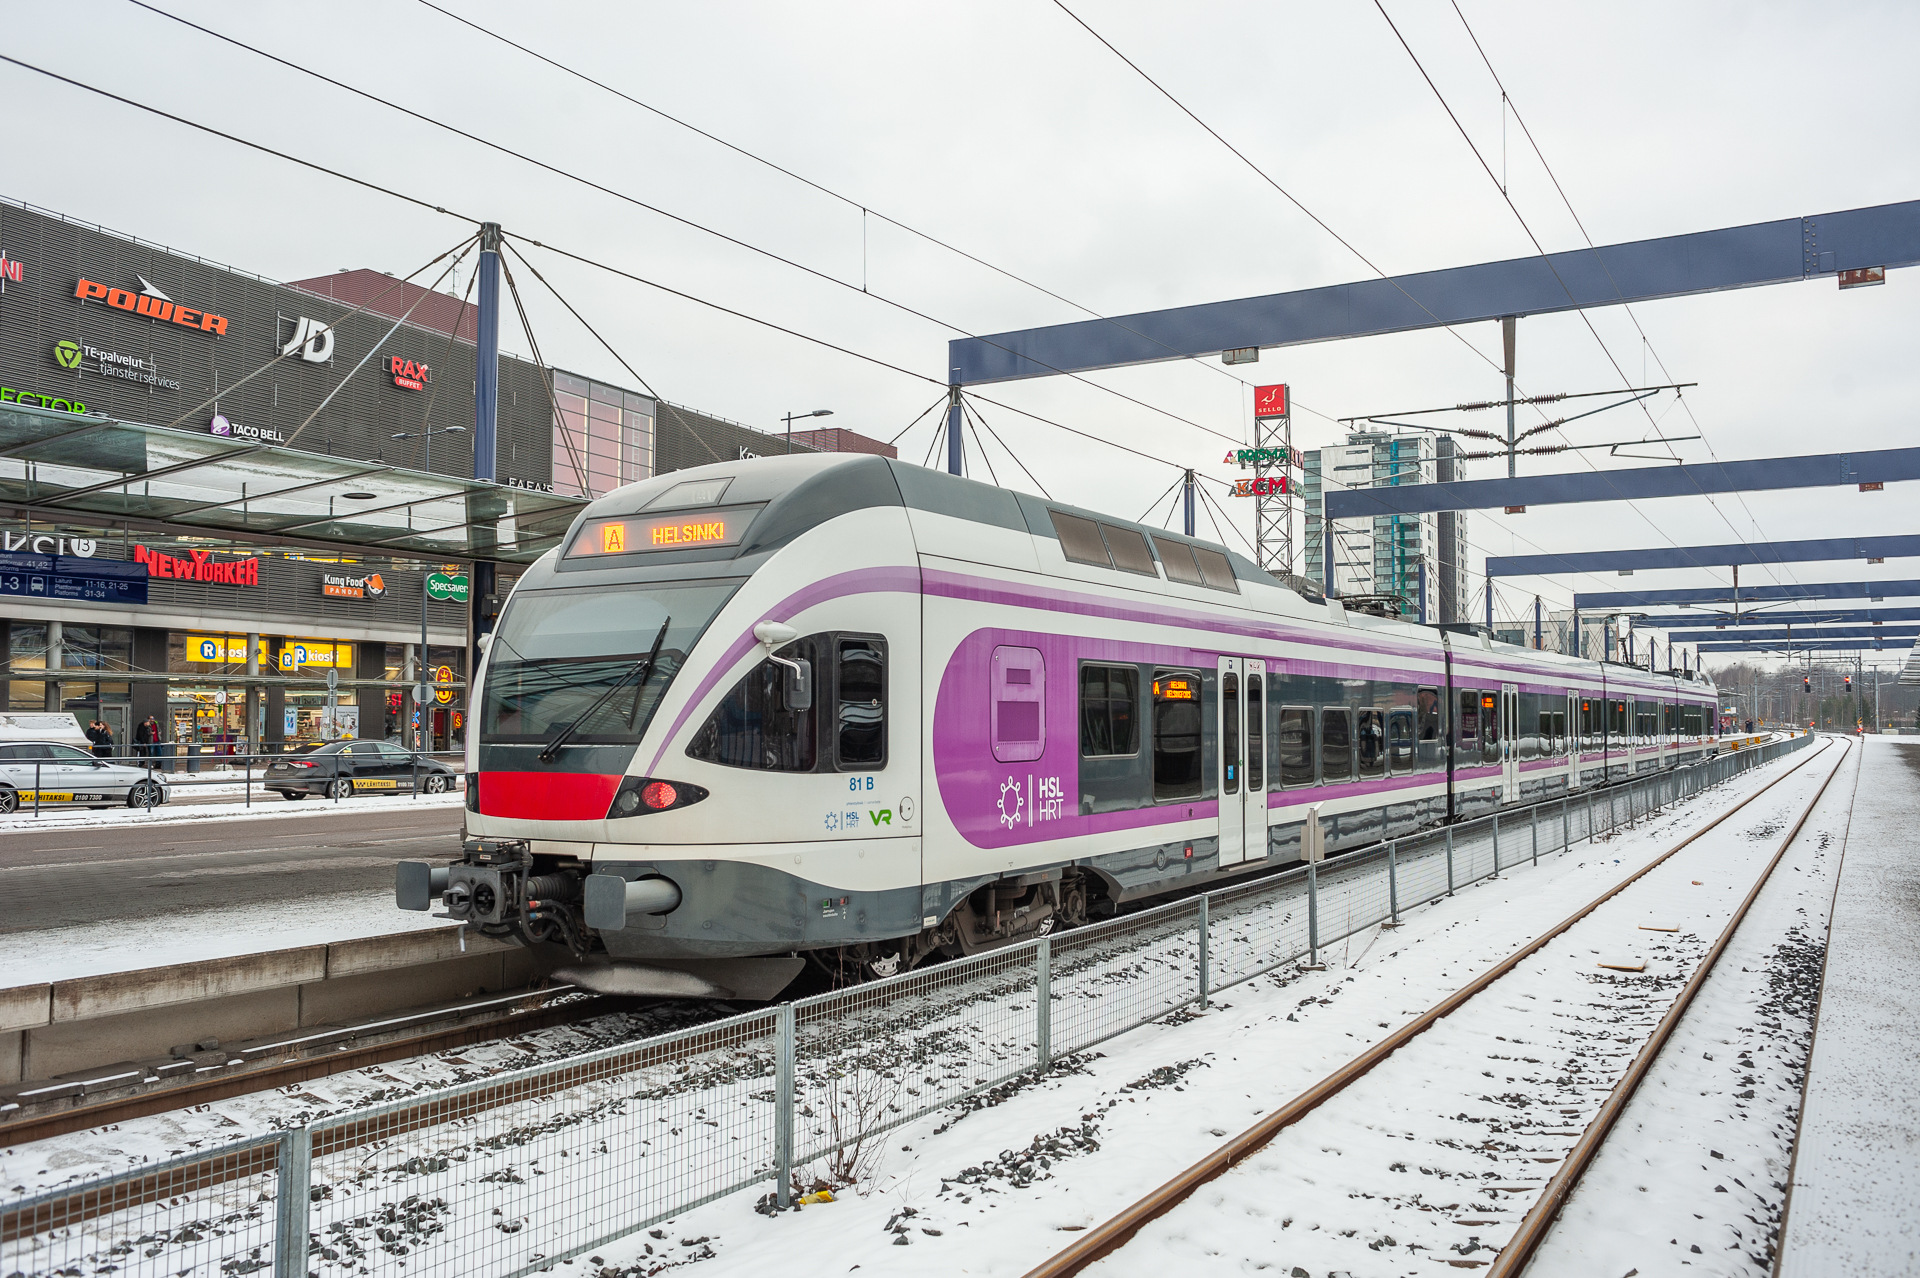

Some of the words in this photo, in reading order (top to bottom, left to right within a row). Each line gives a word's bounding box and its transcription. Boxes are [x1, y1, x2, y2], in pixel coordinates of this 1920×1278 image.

[76, 278, 228, 335] POWER
[282, 316, 335, 363] JD
[83, 345, 144, 369] TE-palvelut
[391, 356, 428, 382] RAX
[143, 374, 181, 391] services
[398, 378, 421, 389] BUFFET
[231, 423, 259, 439] TACO
[260, 428, 285, 442] BELL
[1237, 447, 1287, 462] PRISMA
[652, 522, 724, 545] HELSINKI
[324, 574, 345, 588] Kung
[346, 577, 364, 588] Food
[84, 590, 105, 598] 31-34
[329, 587, 358, 596] PANDA
[1153, 681, 1160, 695] A
[849, 777, 862, 791] 81
[866, 776, 874, 791] B
[1039, 776, 1064, 799] HSL
[846, 811, 860, 820] HSL
[868, 808, 892, 827] VR
[1039, 799, 1064, 822] HRT
[846, 819, 860, 828] HRT
